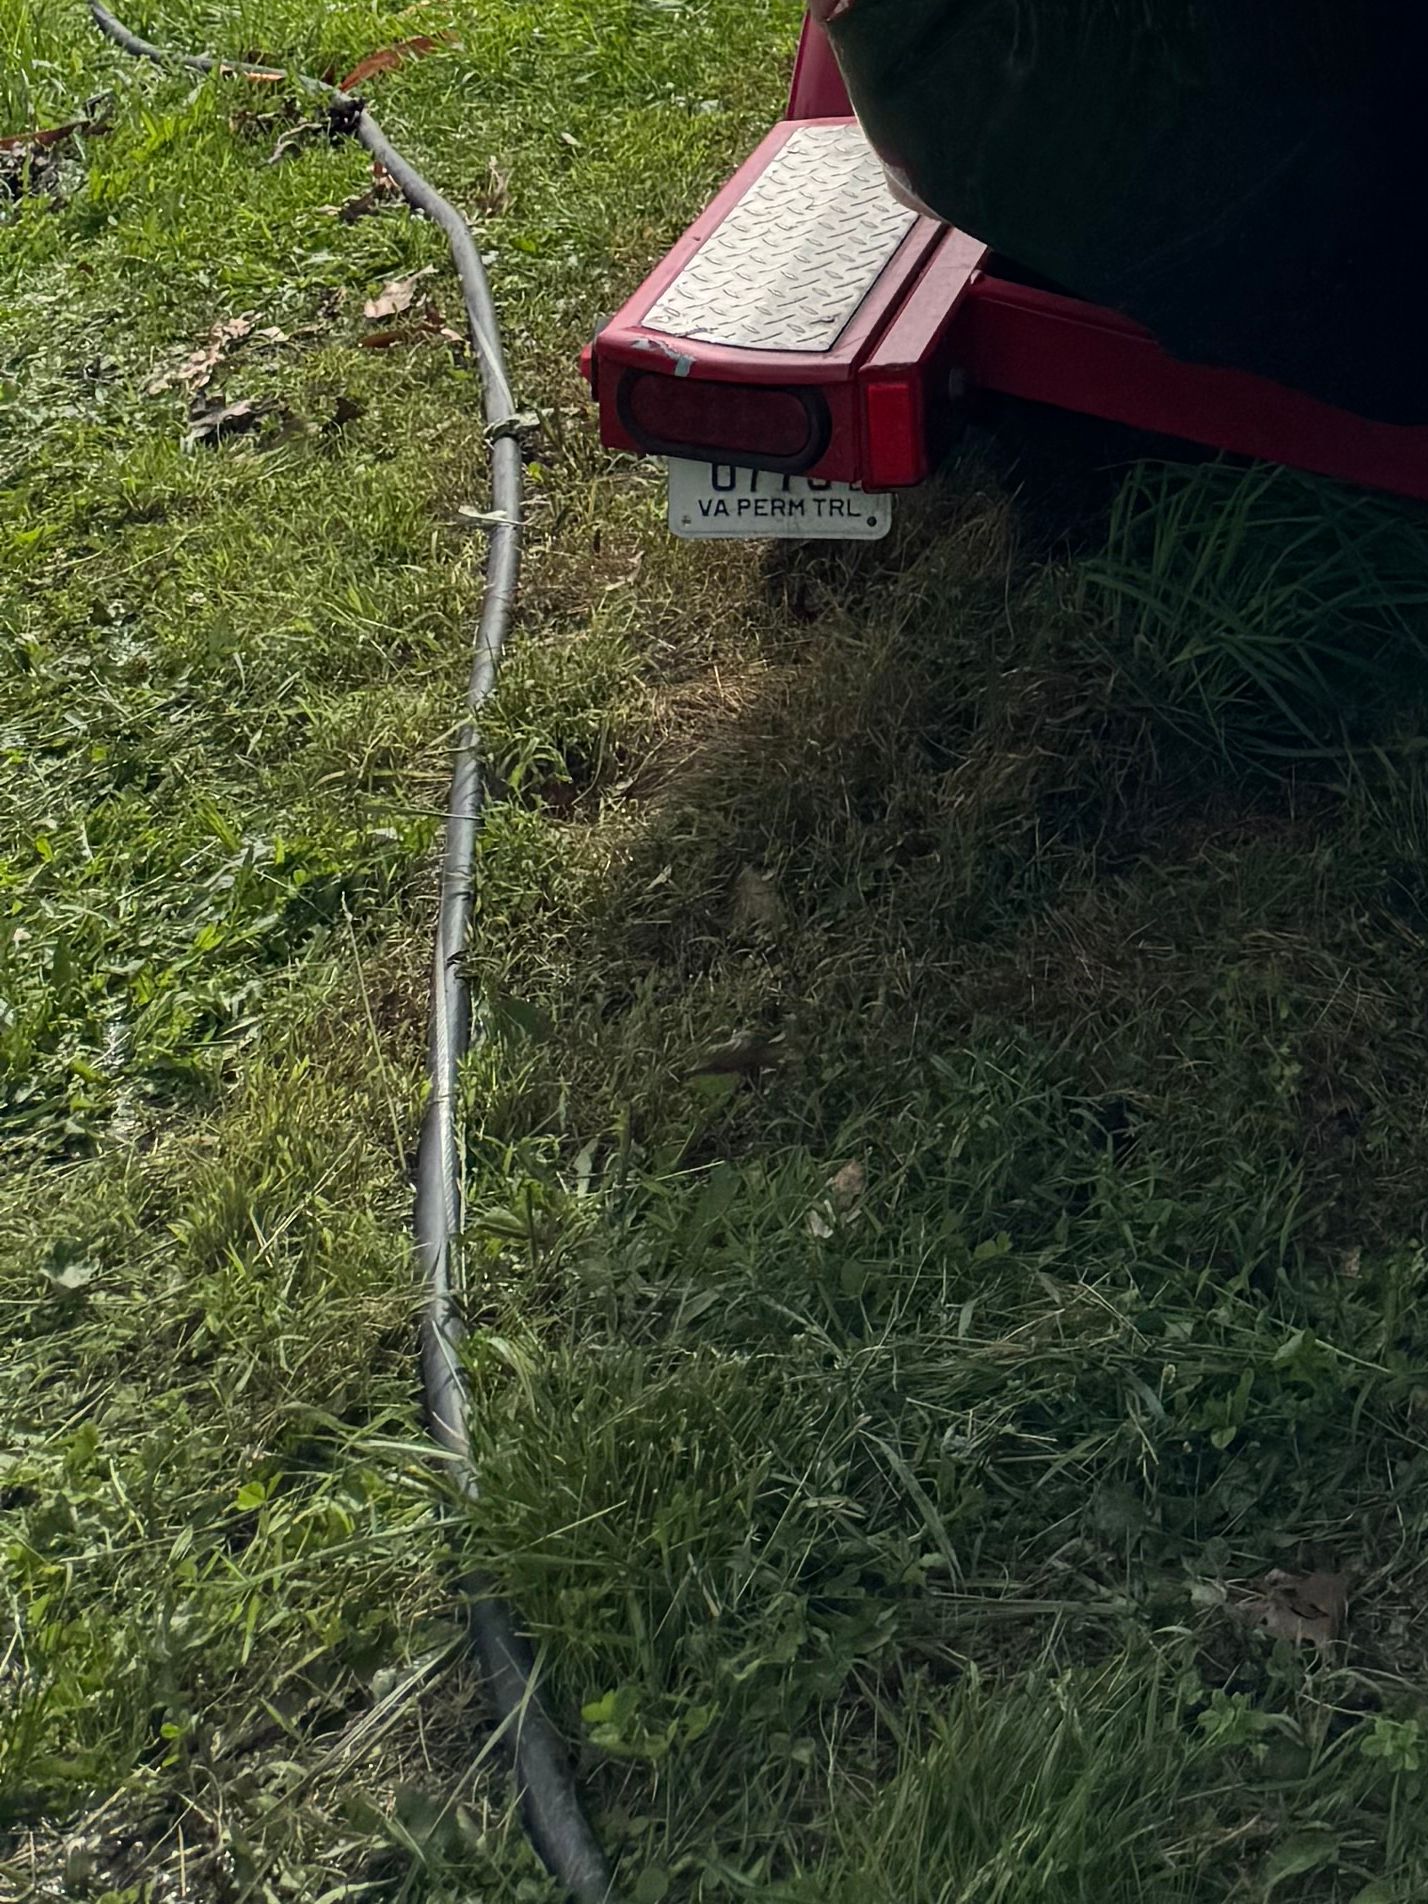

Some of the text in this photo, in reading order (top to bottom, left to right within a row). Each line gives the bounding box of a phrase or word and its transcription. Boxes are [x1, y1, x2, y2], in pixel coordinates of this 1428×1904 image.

[698, 498, 862, 517] VA PERM TRL
